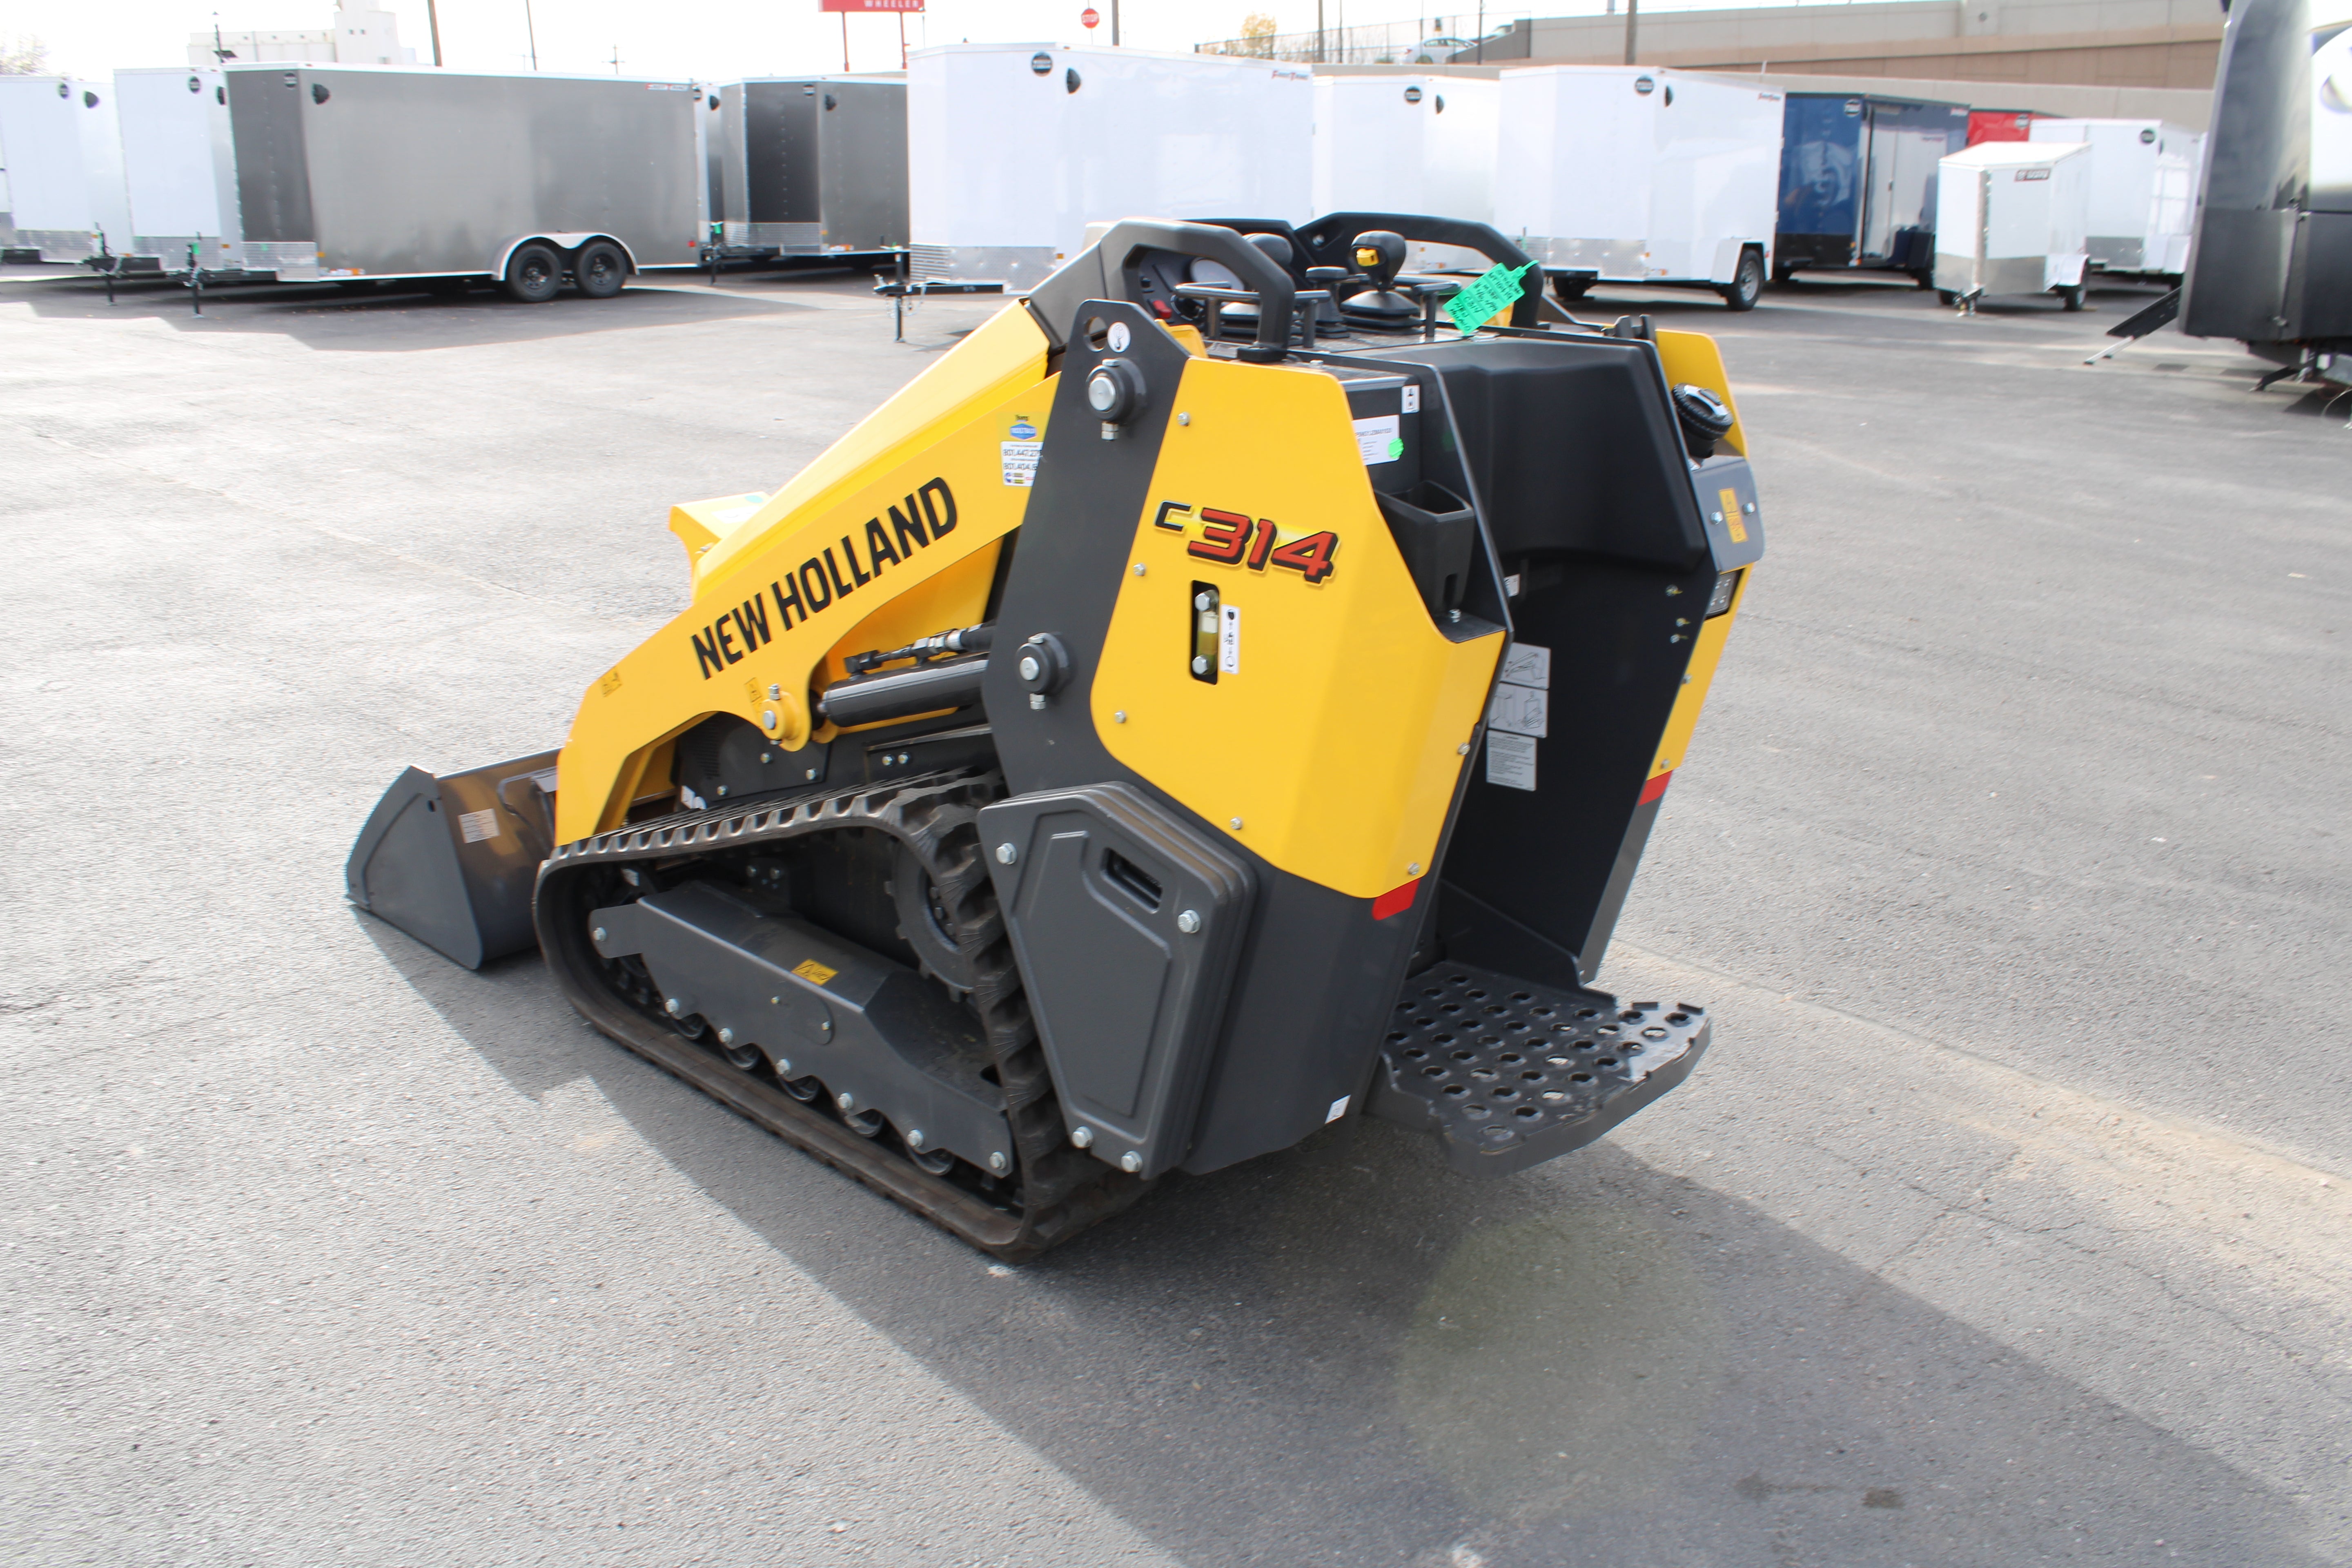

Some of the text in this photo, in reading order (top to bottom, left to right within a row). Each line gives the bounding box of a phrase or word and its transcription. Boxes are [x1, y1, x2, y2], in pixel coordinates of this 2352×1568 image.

[1082, 14, 1099, 23] STOP
[690, 477, 958, 680] NEW HOLLAND
[1154, 500, 1339, 585] C314
